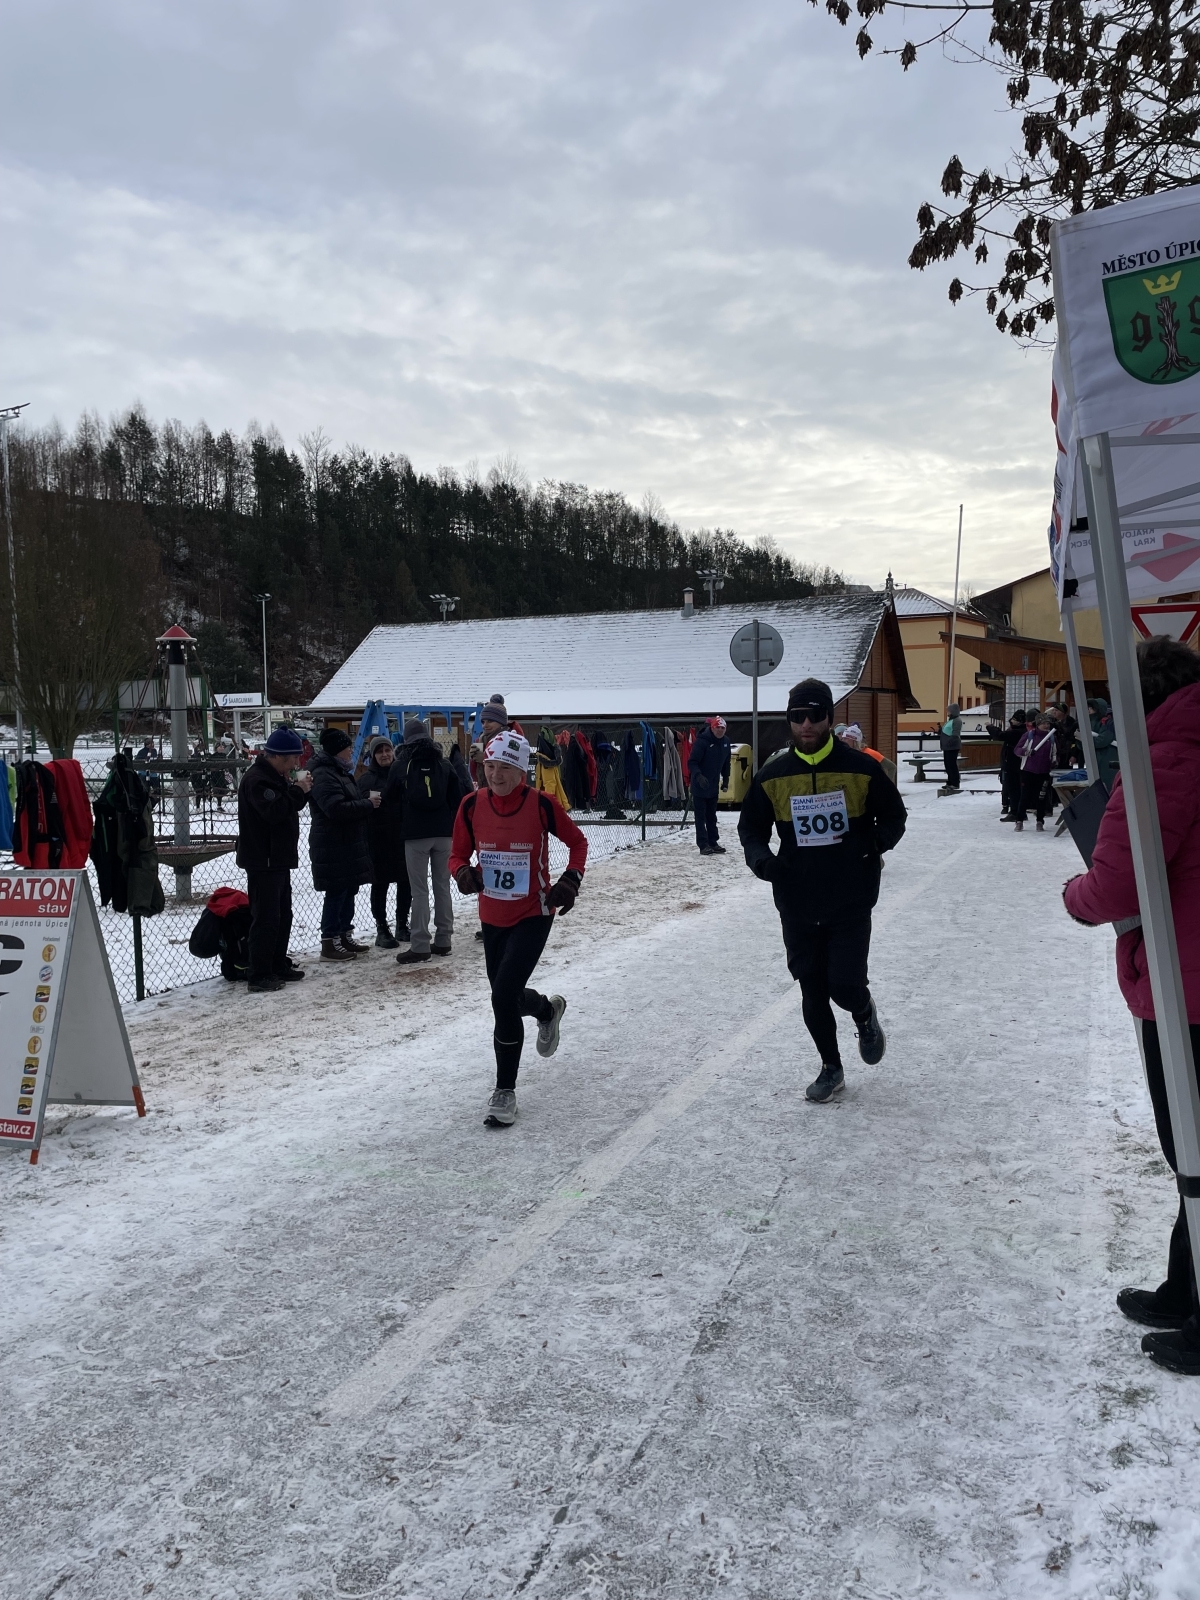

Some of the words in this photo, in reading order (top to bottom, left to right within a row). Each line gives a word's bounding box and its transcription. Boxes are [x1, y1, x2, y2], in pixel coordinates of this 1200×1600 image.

[1102, 248, 1161, 275] MĚSTO
[792, 797, 814, 805] ZIMNÍ
[797, 811, 845, 836] 308
[480, 853, 501, 861] ZIMNÍ
[493, 869, 515, 890] 18
[38, 902, 68, 914] stav
[11, 919, 42, 928] jednota
[45, 918, 69, 929] Úpice
